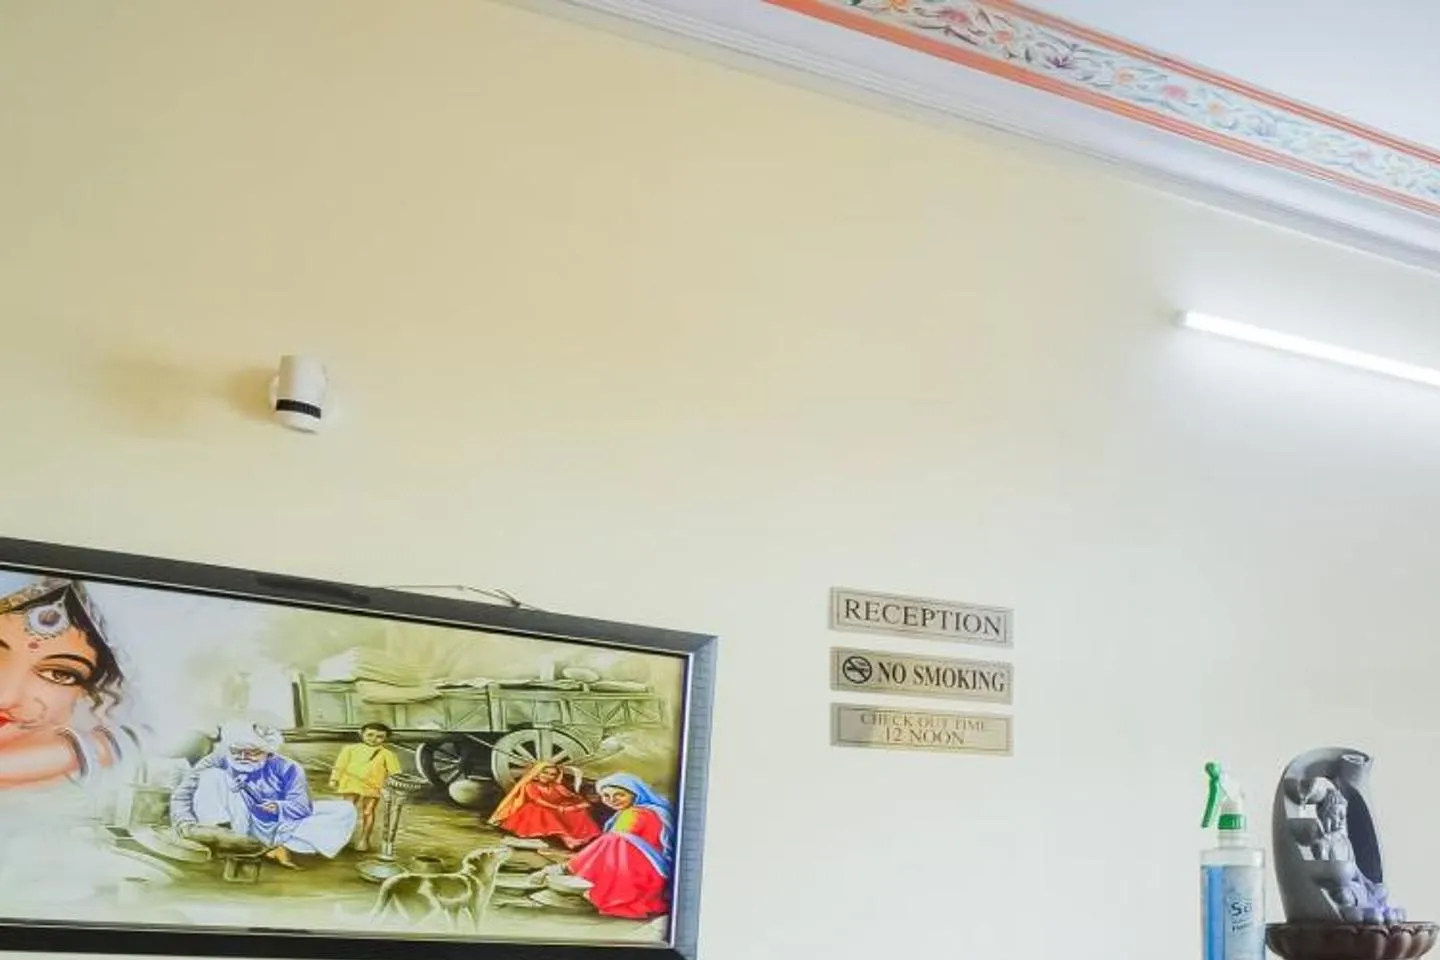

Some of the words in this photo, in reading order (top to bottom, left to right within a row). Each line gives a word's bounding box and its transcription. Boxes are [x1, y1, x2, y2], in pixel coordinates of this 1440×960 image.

[844, 598, 1002, 637] RECEPTION
[878, 661, 907, 685] NO
[913, 664, 1005, 693] SMOKING
[860, 711, 914, 728] CHECK
[918, 713, 948, 729] OUT
[885, 727, 902, 742] 12
[910, 728, 965, 745] NOON
